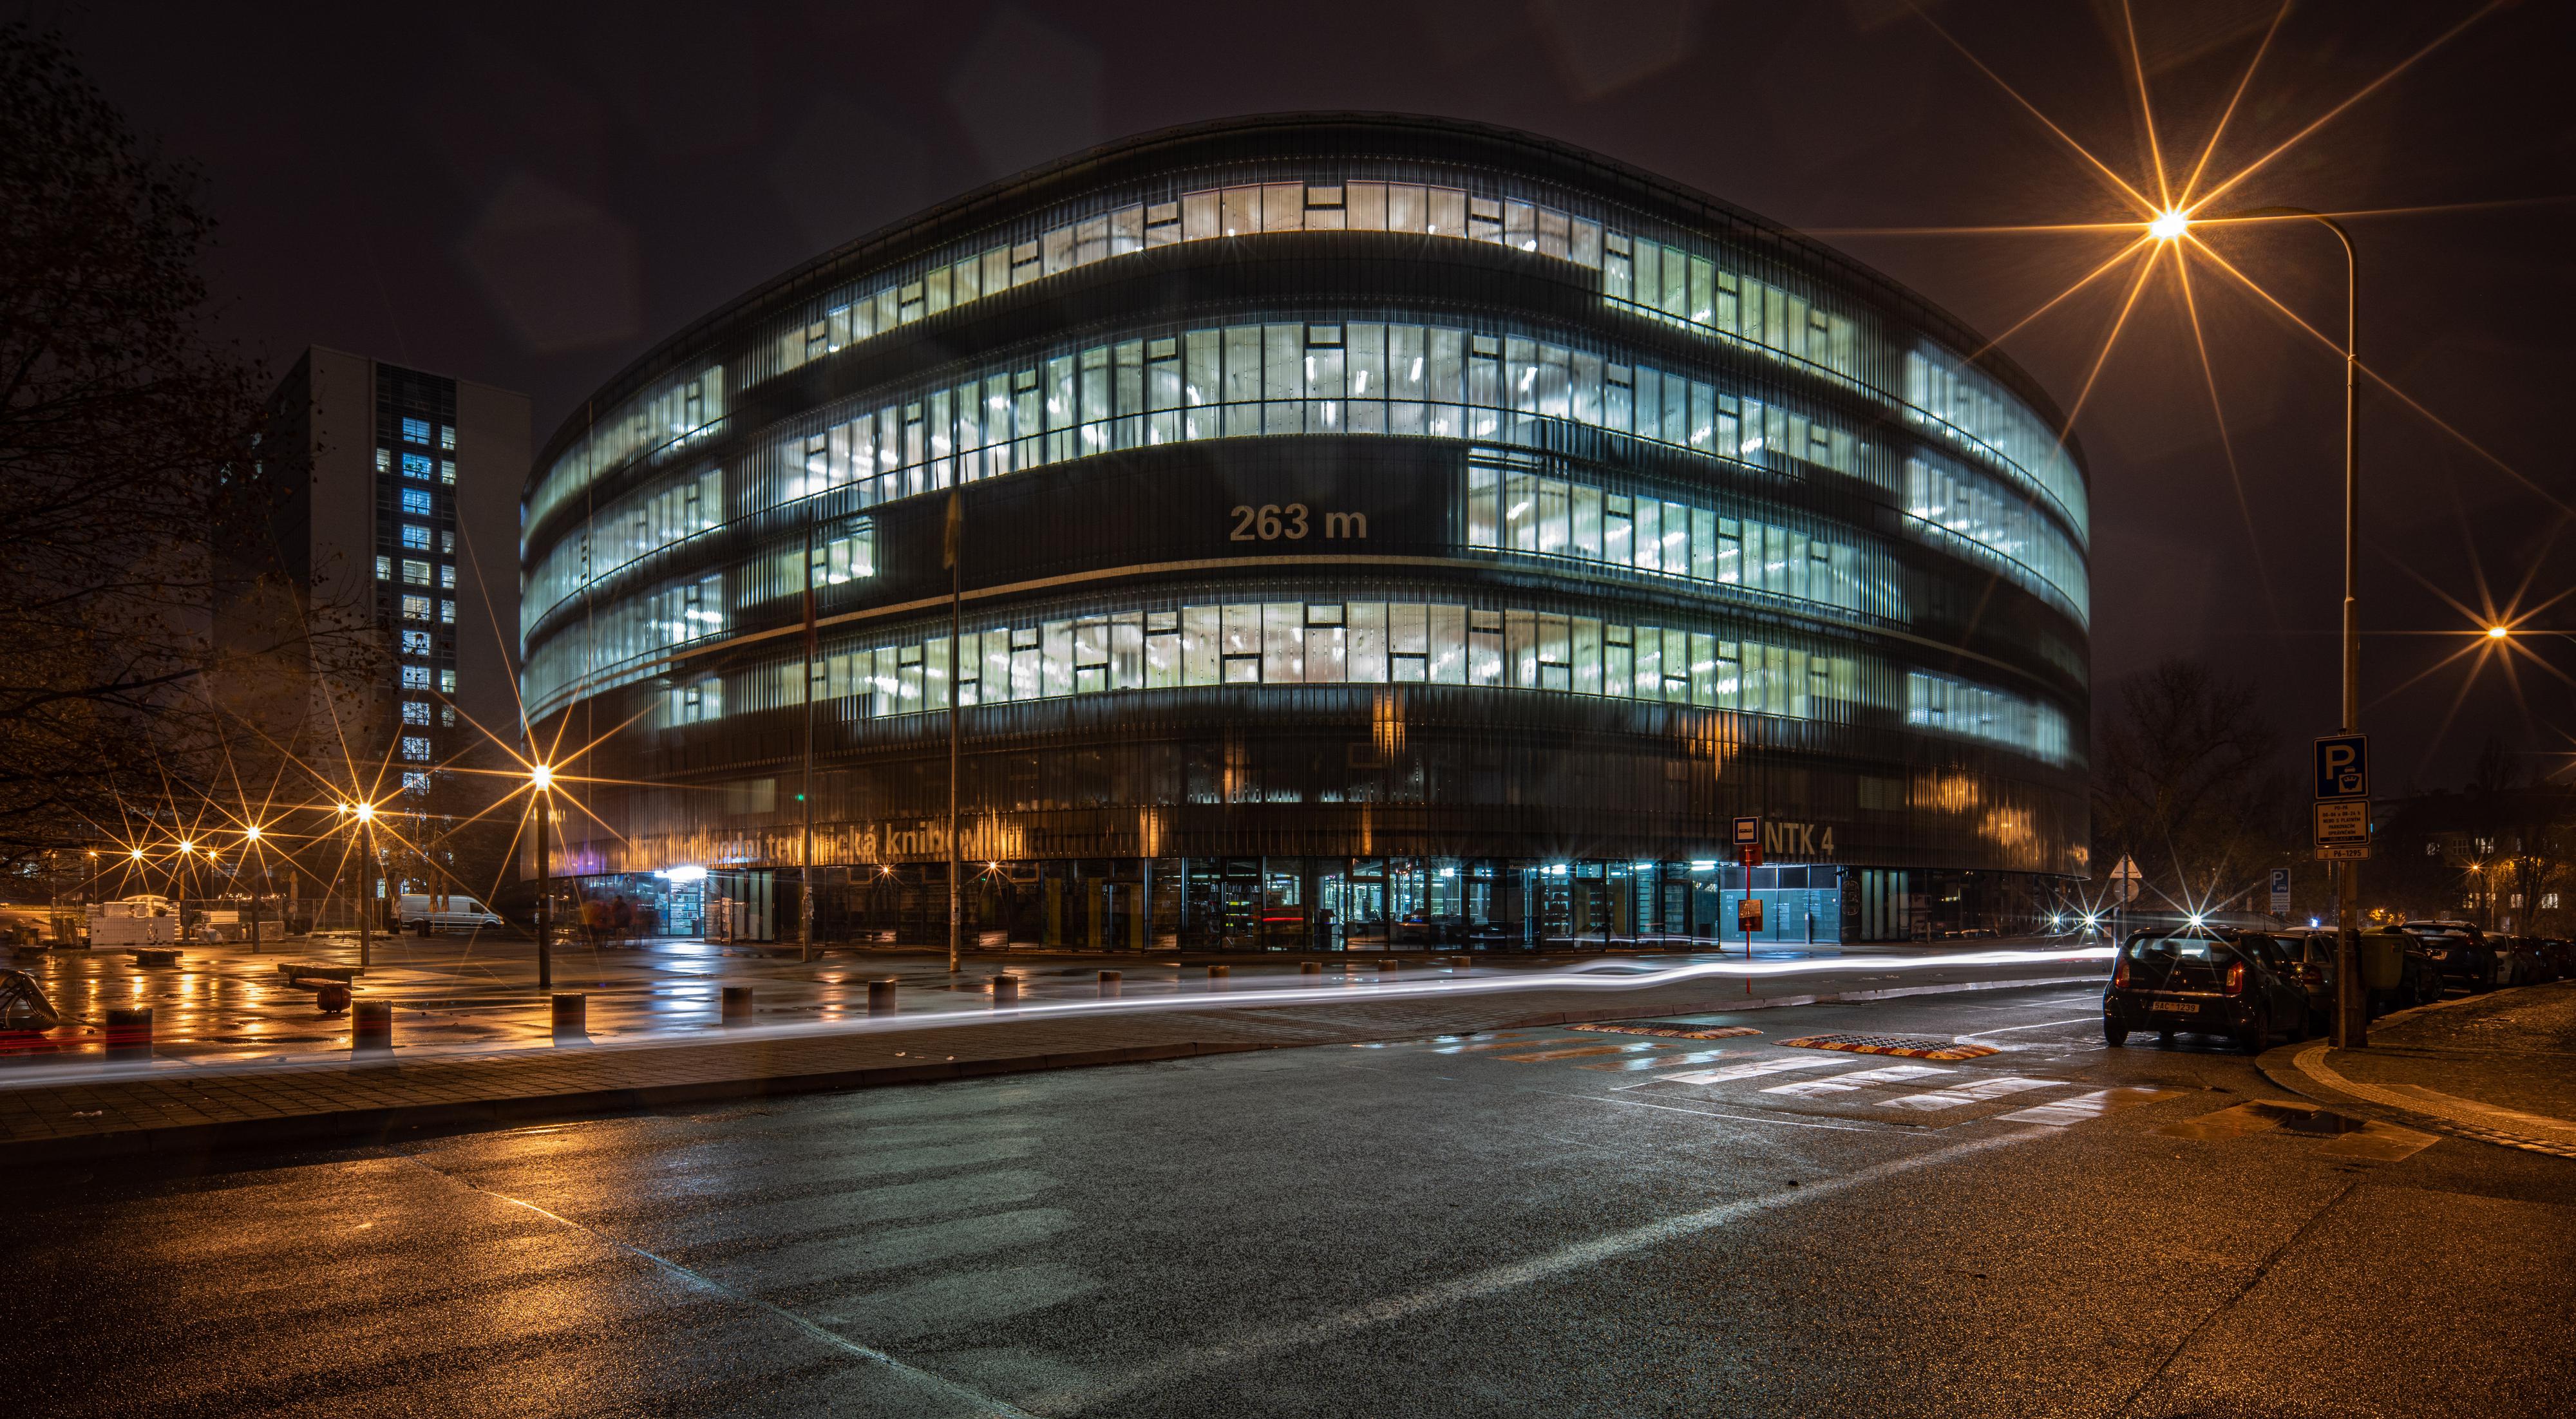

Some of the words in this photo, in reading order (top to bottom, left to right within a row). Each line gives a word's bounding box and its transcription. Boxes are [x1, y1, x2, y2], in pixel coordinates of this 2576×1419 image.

[1230, 503, 1309, 541] 263
[1325, 512, 1367, 539] m
[2325, 744, 2356, 780] P
[766, 824, 877, 860] teická
[1765, 822, 1815, 855] NTK
[1821, 826, 1835, 856] 4
[2273, 871, 2284, 886] P
[2155, 1002, 2170, 1010] 5AC
[2176, 1003, 2196, 1011] 1239
